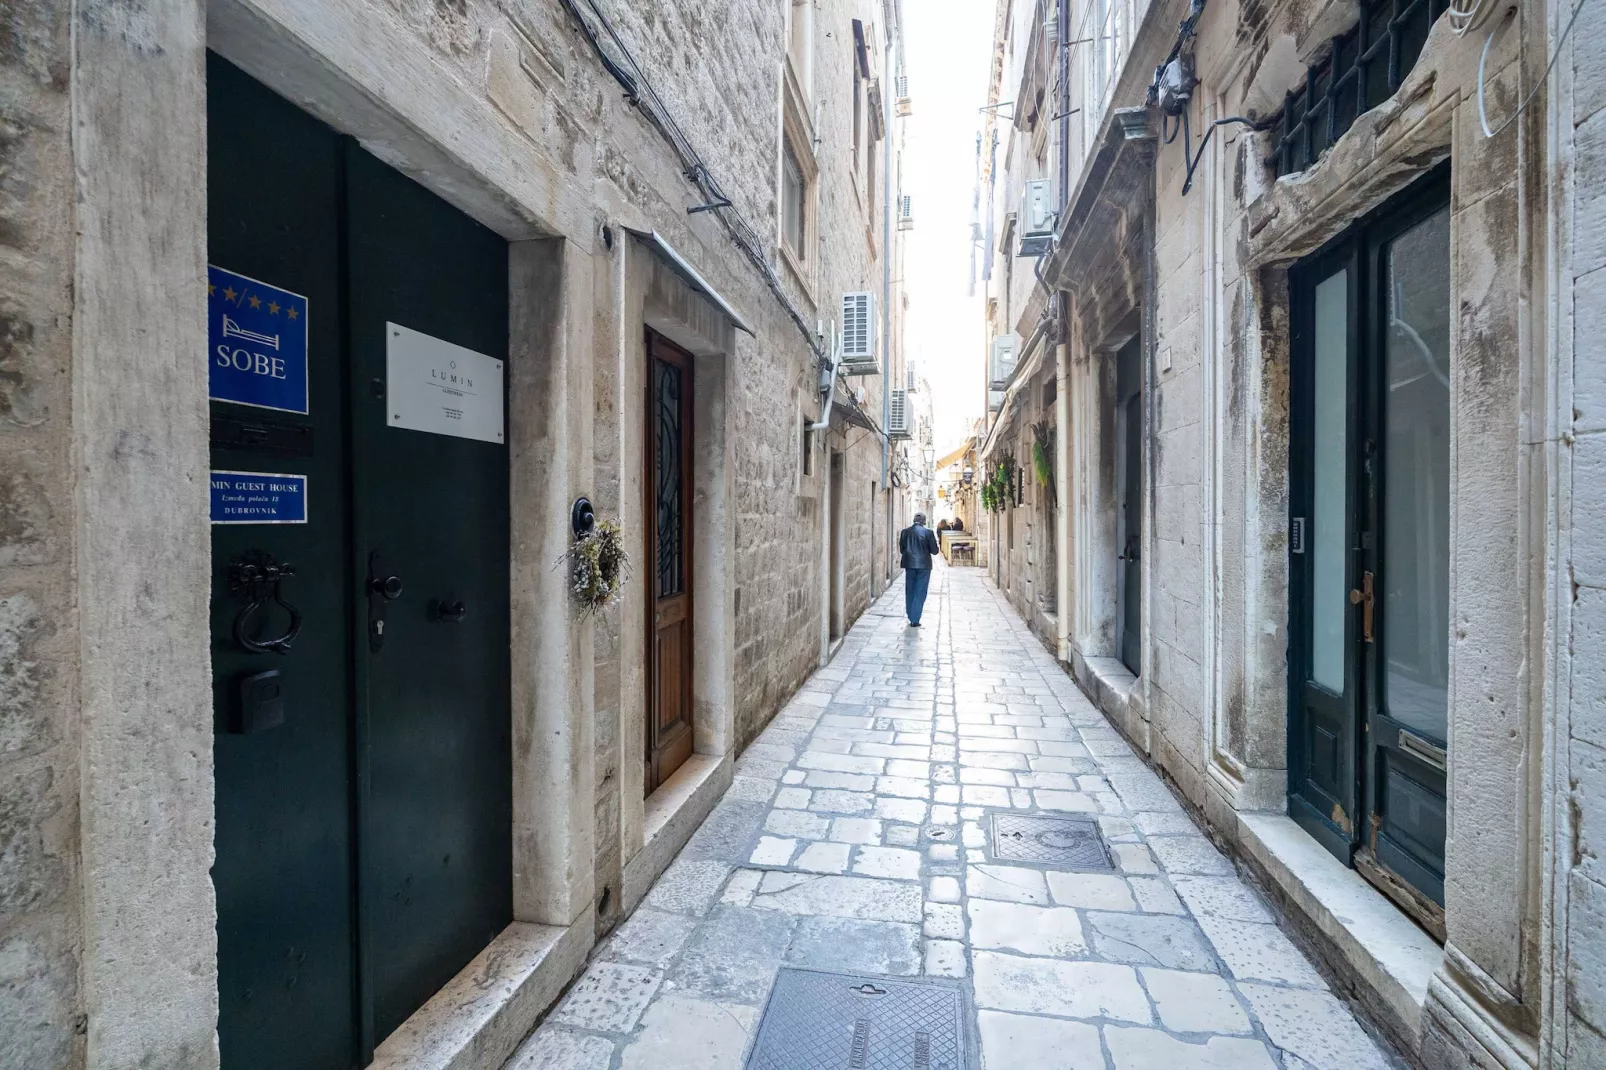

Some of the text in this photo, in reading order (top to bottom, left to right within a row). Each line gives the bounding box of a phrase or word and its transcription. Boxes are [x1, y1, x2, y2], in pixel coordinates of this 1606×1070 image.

[217, 344, 286, 380] SOBE
[432, 369, 473, 387] LUMIN
[235, 483, 265, 491] GUEST
[269, 484, 299, 493] HOUSE
[224, 507, 277, 515] DUBROVNIK
